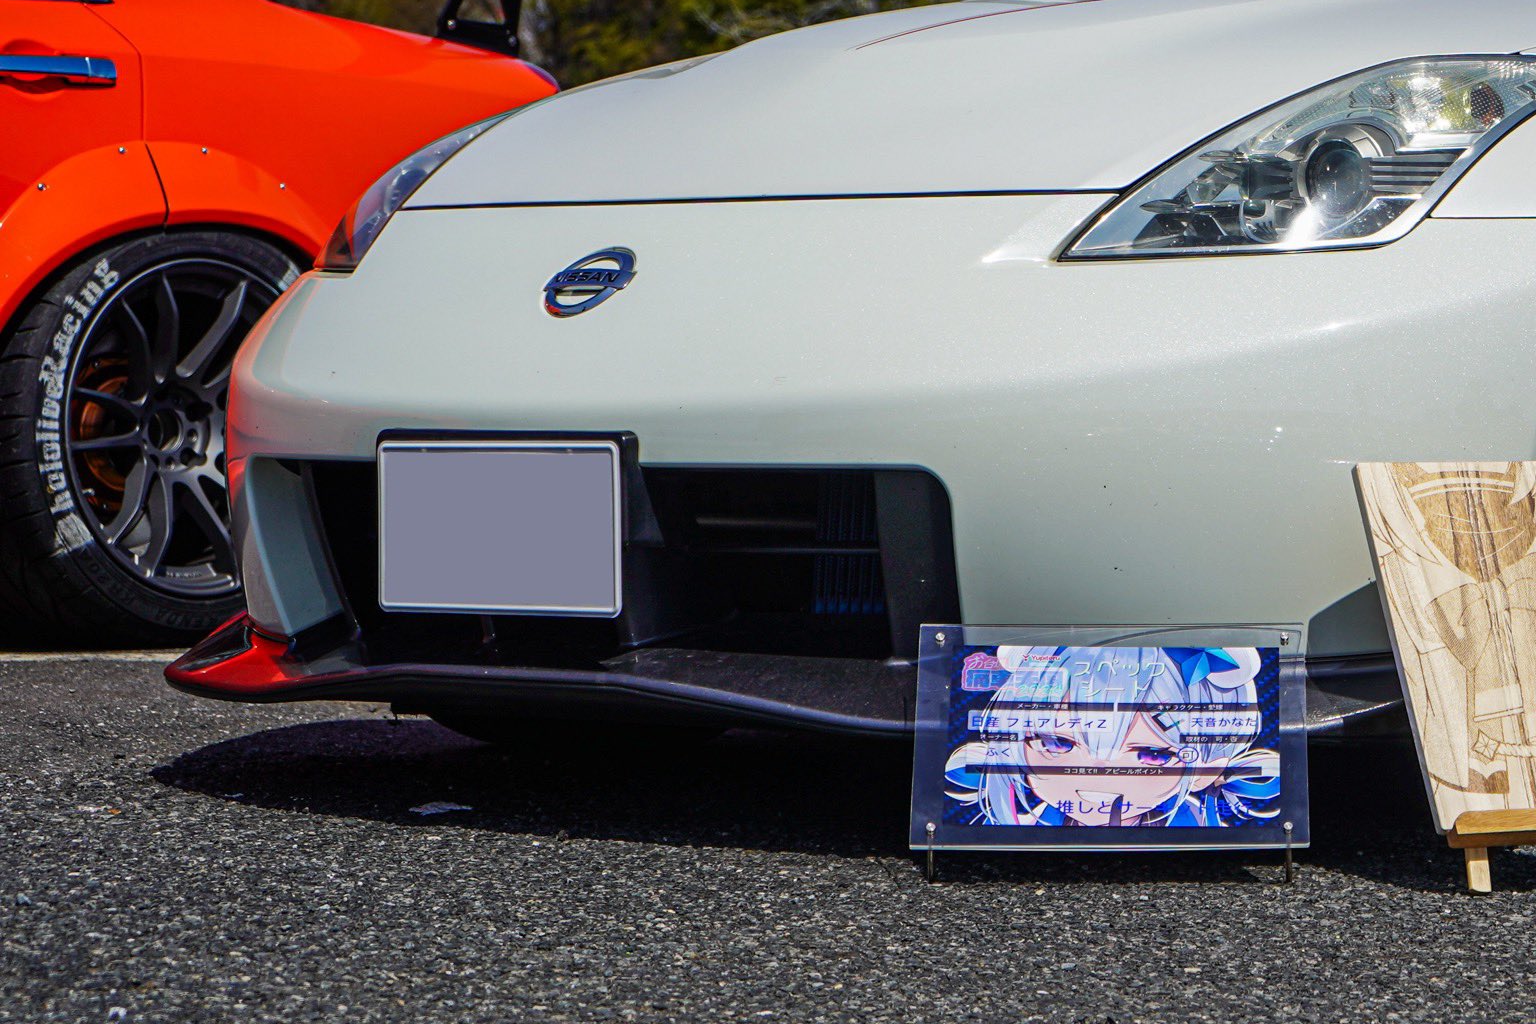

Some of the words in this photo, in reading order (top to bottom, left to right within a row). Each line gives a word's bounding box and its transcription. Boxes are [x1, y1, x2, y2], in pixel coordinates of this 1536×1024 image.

[554, 271, 620, 283] NISSAN
[1074, 659, 1166, 677] スペック
[973, 716, 1000, 728] 日産
[1007, 717, 1107, 729] フェアレディZ
[1191, 717, 1257, 728] 天音かなた
